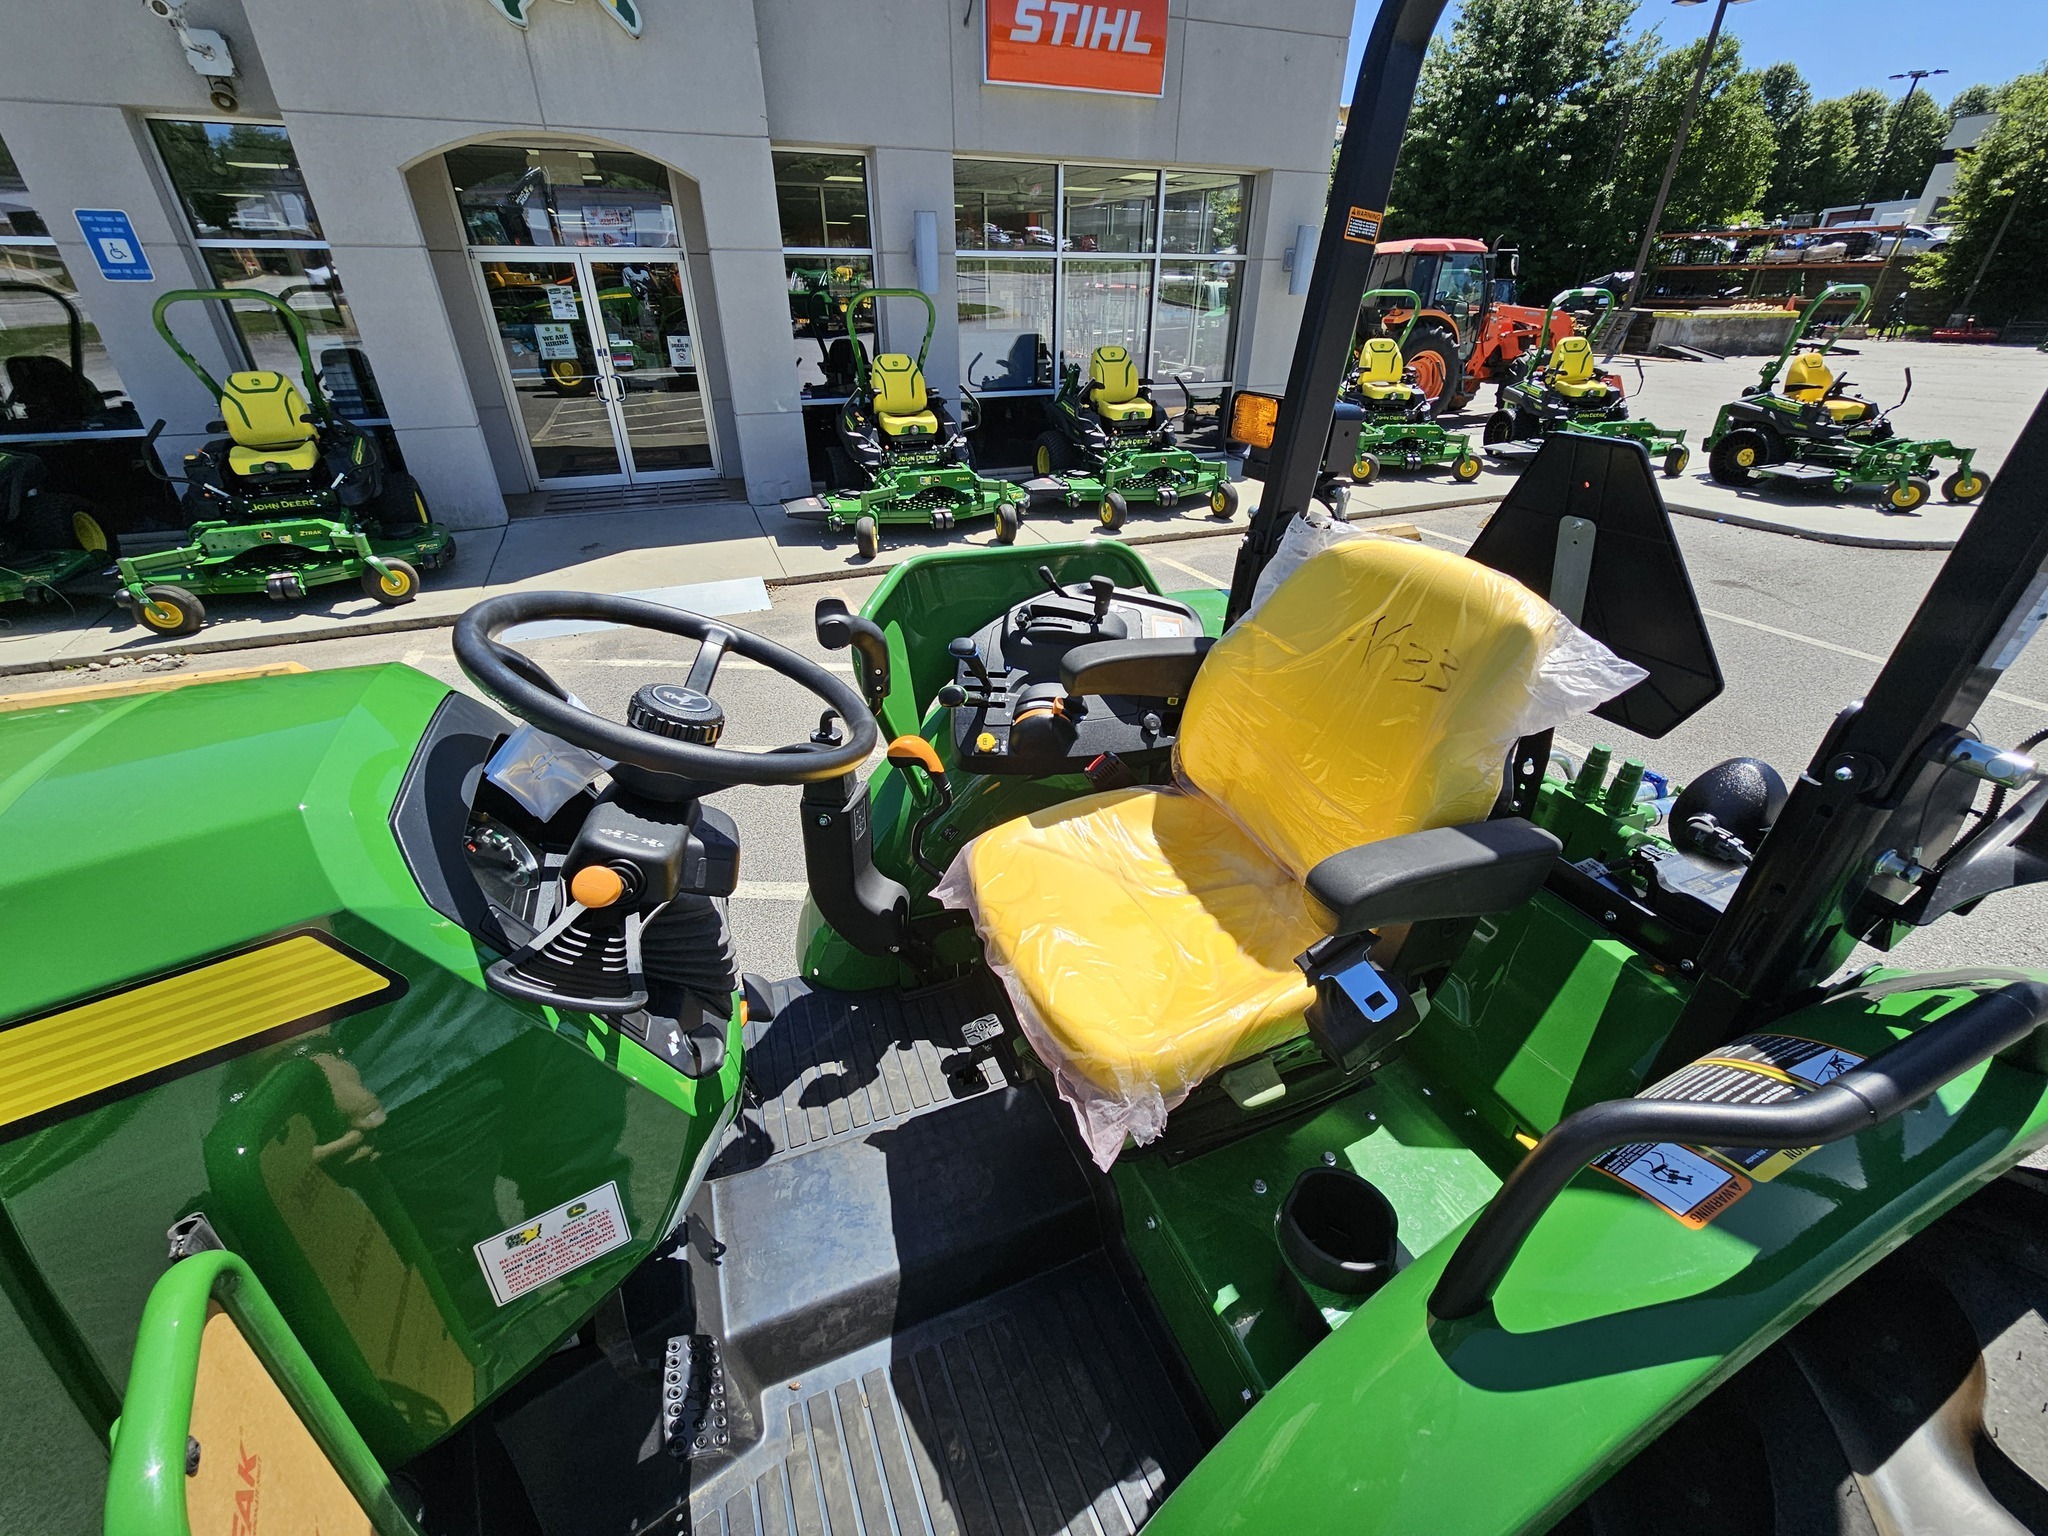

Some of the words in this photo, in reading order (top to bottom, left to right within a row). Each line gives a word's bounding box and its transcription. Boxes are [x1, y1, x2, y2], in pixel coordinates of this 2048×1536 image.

[1009, 0, 1152, 54] STIHL
[1357, 210, 1381, 221] WARNING
[545, 339, 570, 347] HIRING
[252, 502, 280, 511] JOHN
[280, 499, 317, 508] DEERE
[562, 1218, 578, 1229] JOHN
[577, 1209, 598, 1221] DEERE
[1689, 1186, 1737, 1223] WARNING
[499, 1242, 541, 1265] RE-TORQUE
[545, 1234, 557, 1243] ALL
[560, 1221, 584, 1235] WHEEL
[588, 1209, 610, 1222] BOLTS
[501, 1257, 523, 1270] AFTER
[533, 1244, 550, 1255] AND
[550, 1237, 563, 1246] 100
[563, 1226, 587, 1240] HOURS
[596, 1215, 609, 1223] USE.
[503, 1262, 523, 1275] JOHN
[526, 1251, 547, 1264] DEERE
[550, 1242, 566, 1252] AND
[569, 1228, 595, 1243] AG-PRO
[596, 1219, 612, 1229] WILL
[505, 1270, 520, 1280] NOT
[534, 1254, 553, 1265] HELD
[555, 1231, 598, 1255] RESPONSIBLE
[601, 1224, 614, 1233] FOR
[506, 1237, 527, 1250] Pro
[507, 1274, 522, 1285] ANY
[523, 1263, 545, 1277] LOOSE
[578, 1228, 615, 1249] WARRANTY
[508, 1276, 531, 1290] DOES
[534, 1266, 551, 1277] NOT
[555, 1251, 581, 1266] COVER
[584, 1233, 616, 1252] DAMAGE
[510, 1278, 538, 1294] CAUSED
[547, 1262, 569, 1276] LOOSE
